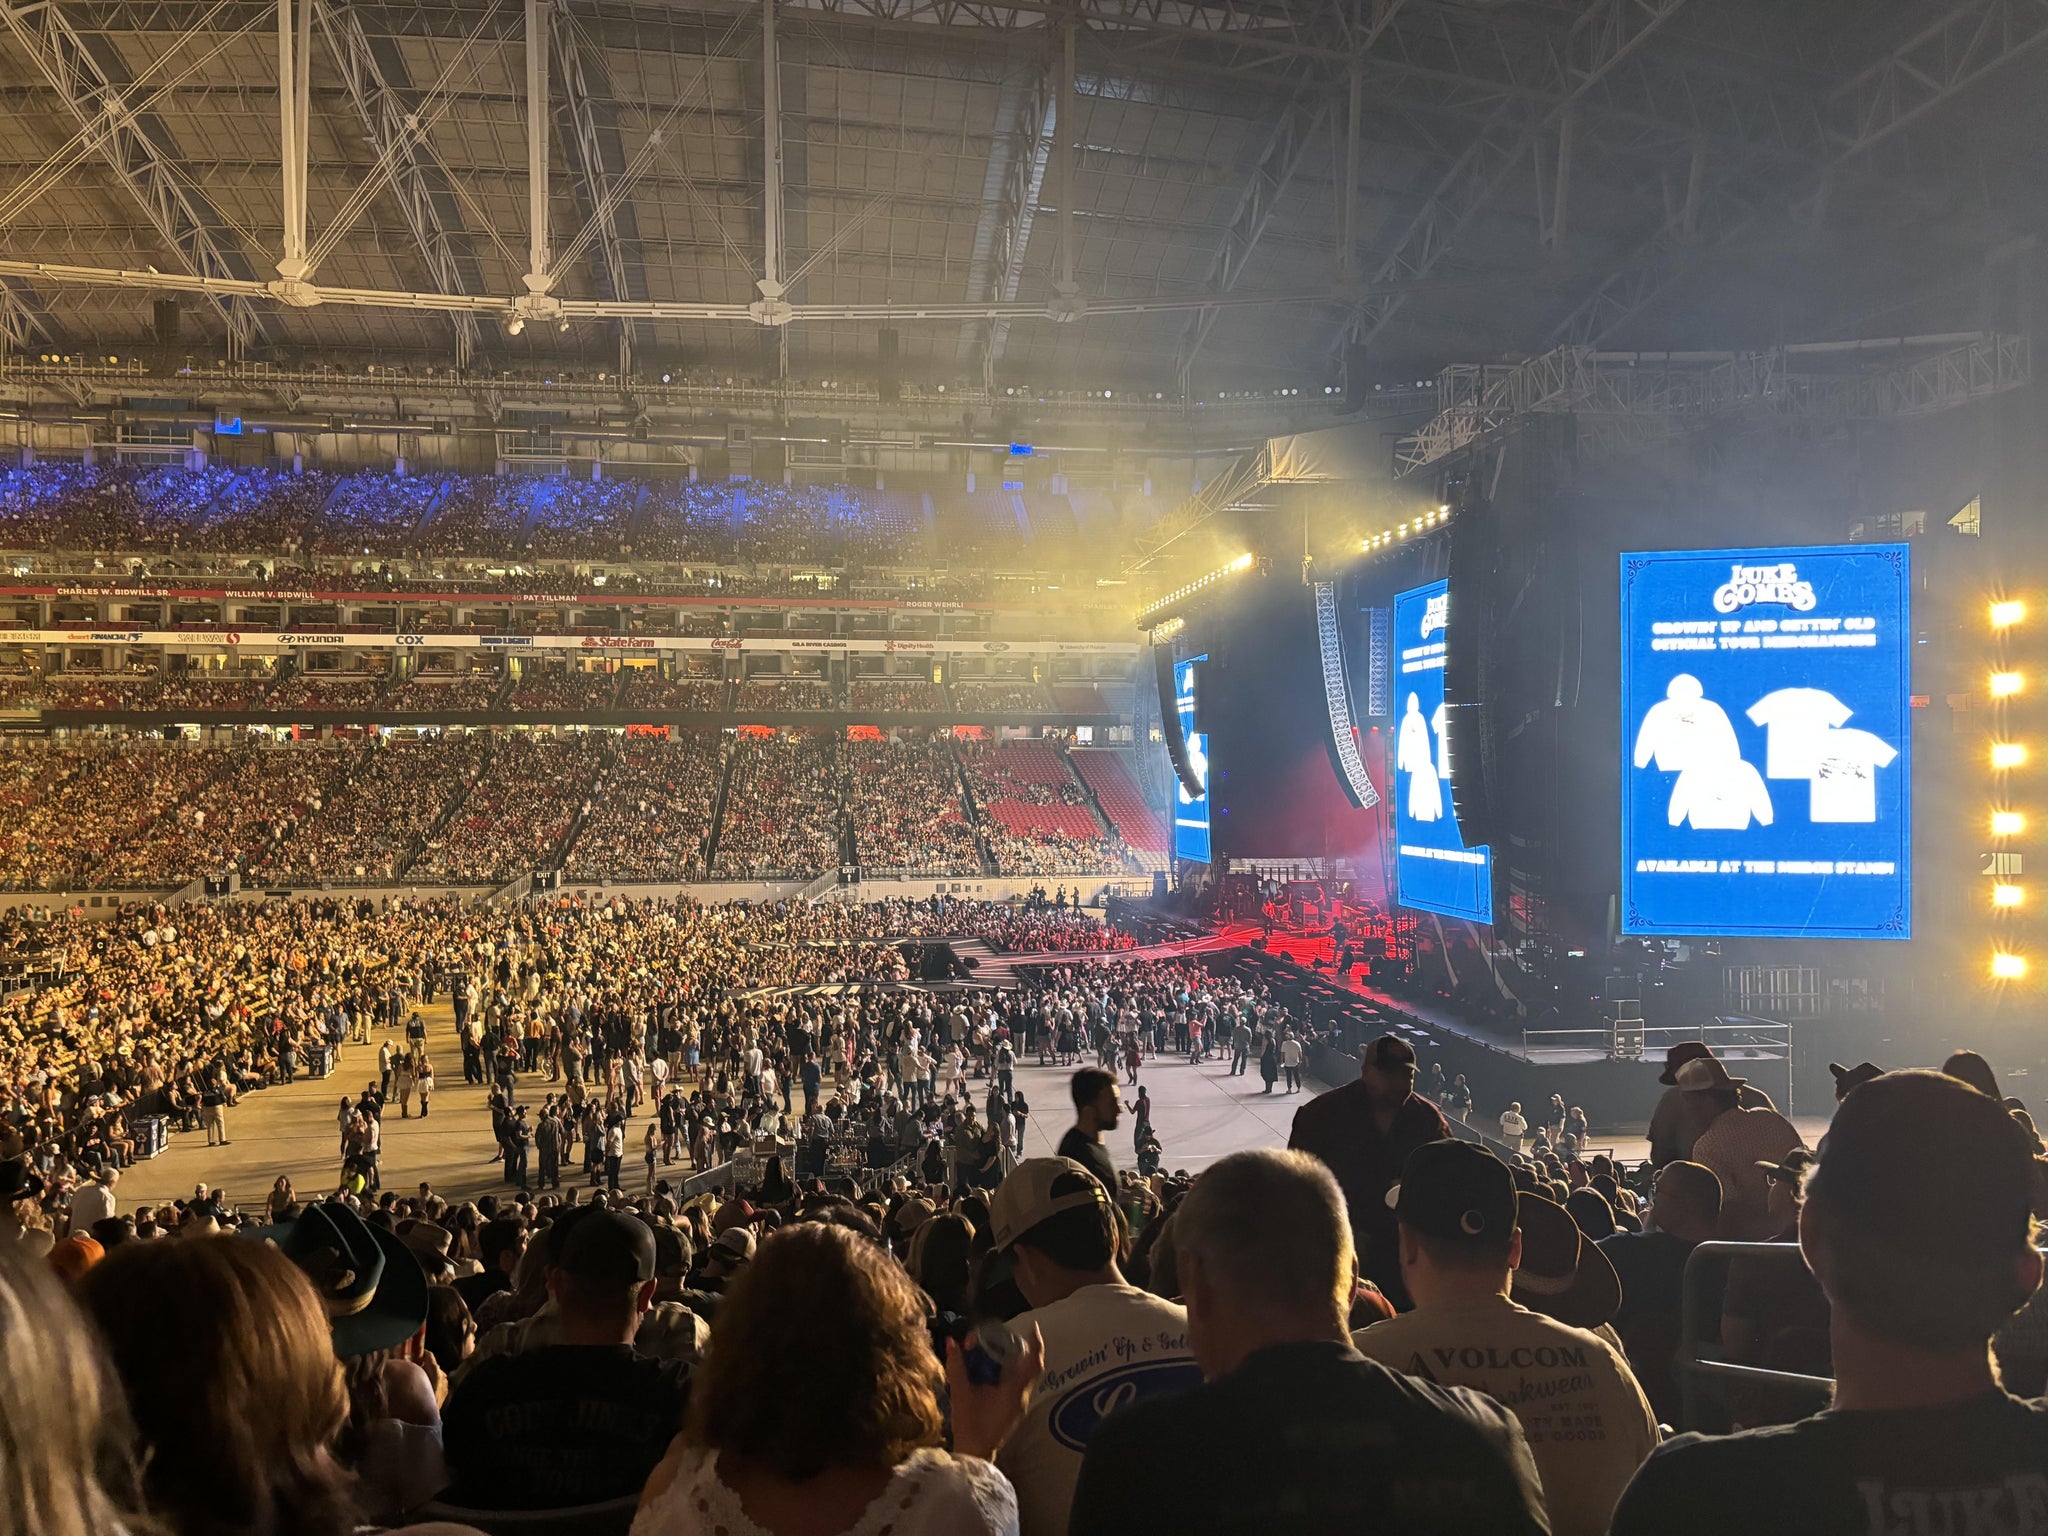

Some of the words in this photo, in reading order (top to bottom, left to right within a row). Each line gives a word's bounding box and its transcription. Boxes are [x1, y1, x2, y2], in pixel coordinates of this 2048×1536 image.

[1730, 562, 1798, 584] LUKE
[101, 588, 113, 596] W.
[156, 589, 172, 597] SR.
[225, 590, 265, 598] WILLIAM
[277, 591, 315, 599] BIDWILL
[1713, 579, 1817, 614] COMBS
[1720, 620, 1742, 633] UP
[1743, 619, 1778, 633] AND
[1843, 617, 1876, 630] OLD
[90, 633, 128, 641] FINANCIAL
[297, 636, 344, 644] HYUNDAI
[396, 635, 425, 645] COX
[1650, 636, 1717, 651] OFFICIAL
[1718, 635, 1760, 650] TOUR
[1762, 633, 1877, 649] MERCHANDISE
[896, 642, 916, 651] Dignity
[916, 643, 934, 651] Health
[1635, 859, 1718, 873] AVAILABLE
[1719, 859, 1741, 873] AT
[1742, 860, 1775, 874] THE
[96, 941, 104, 950] C
[1433, 1345, 1590, 1370] VOLCOM
